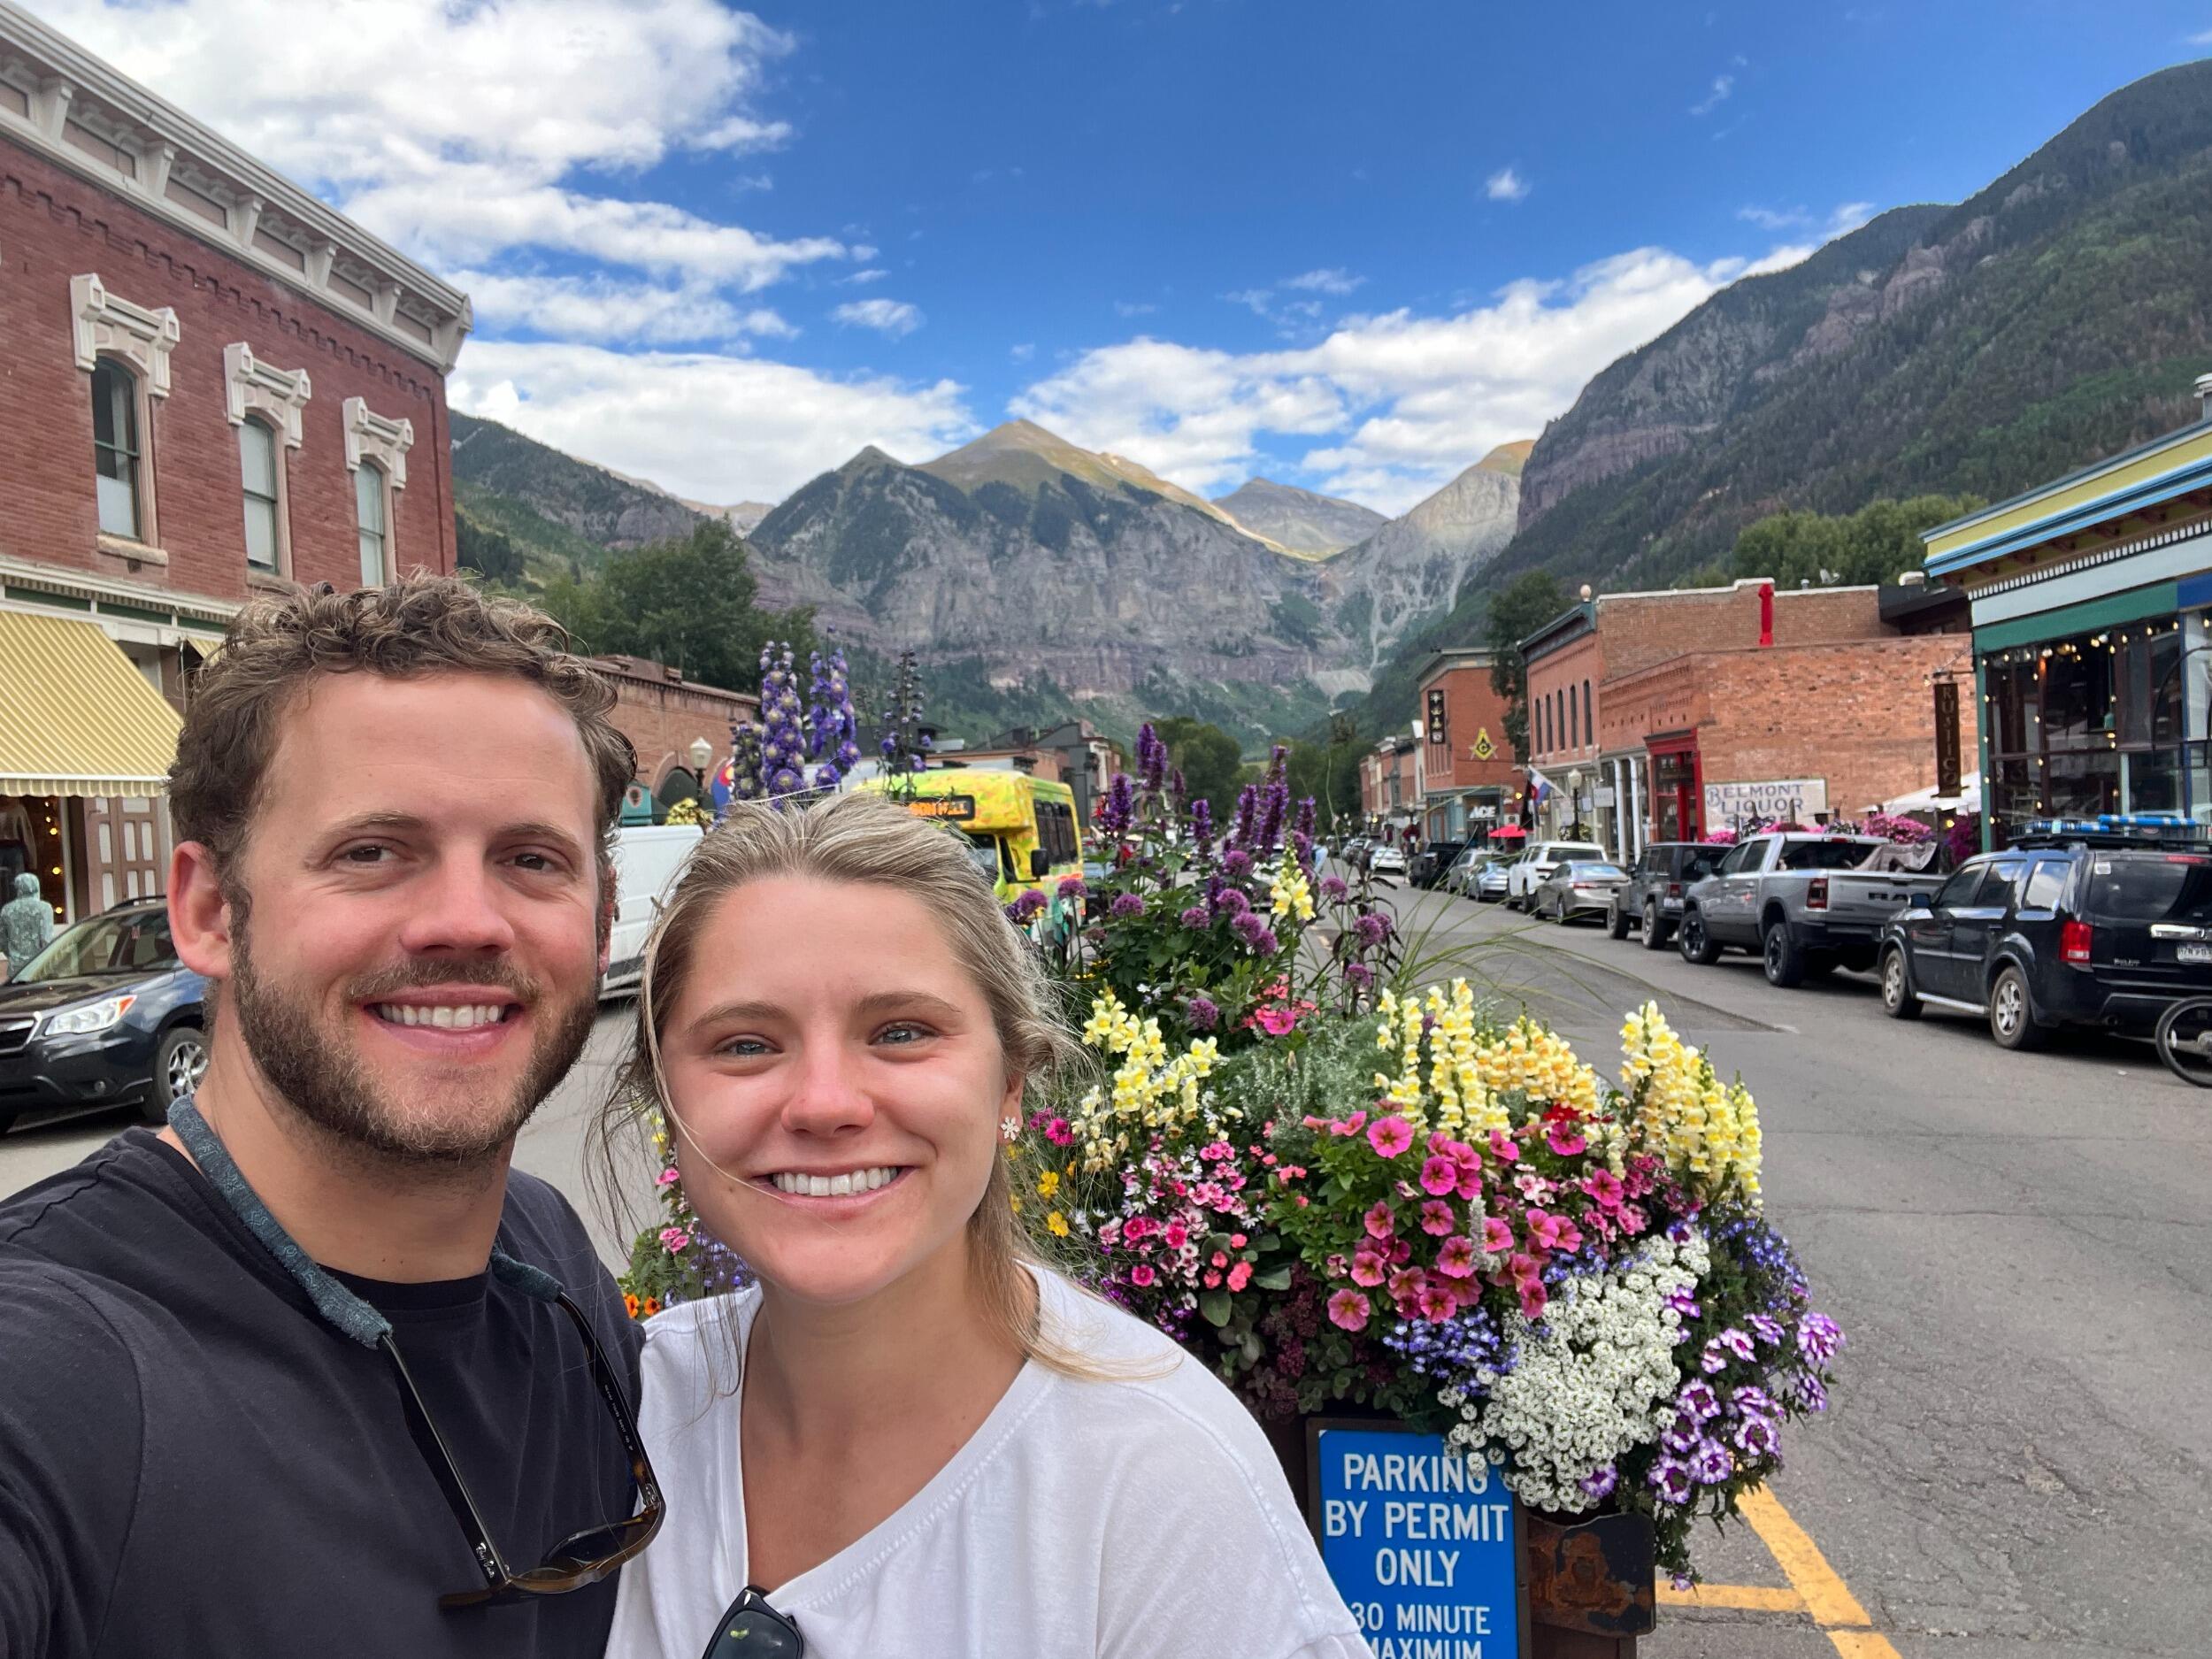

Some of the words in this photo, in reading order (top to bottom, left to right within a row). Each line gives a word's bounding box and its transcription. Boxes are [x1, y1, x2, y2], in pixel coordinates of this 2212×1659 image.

[1707, 784, 1805, 807] BELMONT
[1721, 798, 1804, 814] LIQUOR
[1469, 806, 1496, 819] ACE
[1325, 1500, 1369, 1537] BY
[1385, 1502, 1509, 1542] PERMIT
[1375, 1547, 1460, 1587] ONLY
[1350, 1602, 1384, 1631] 30
[1396, 1603, 1492, 1634] MINUTE
